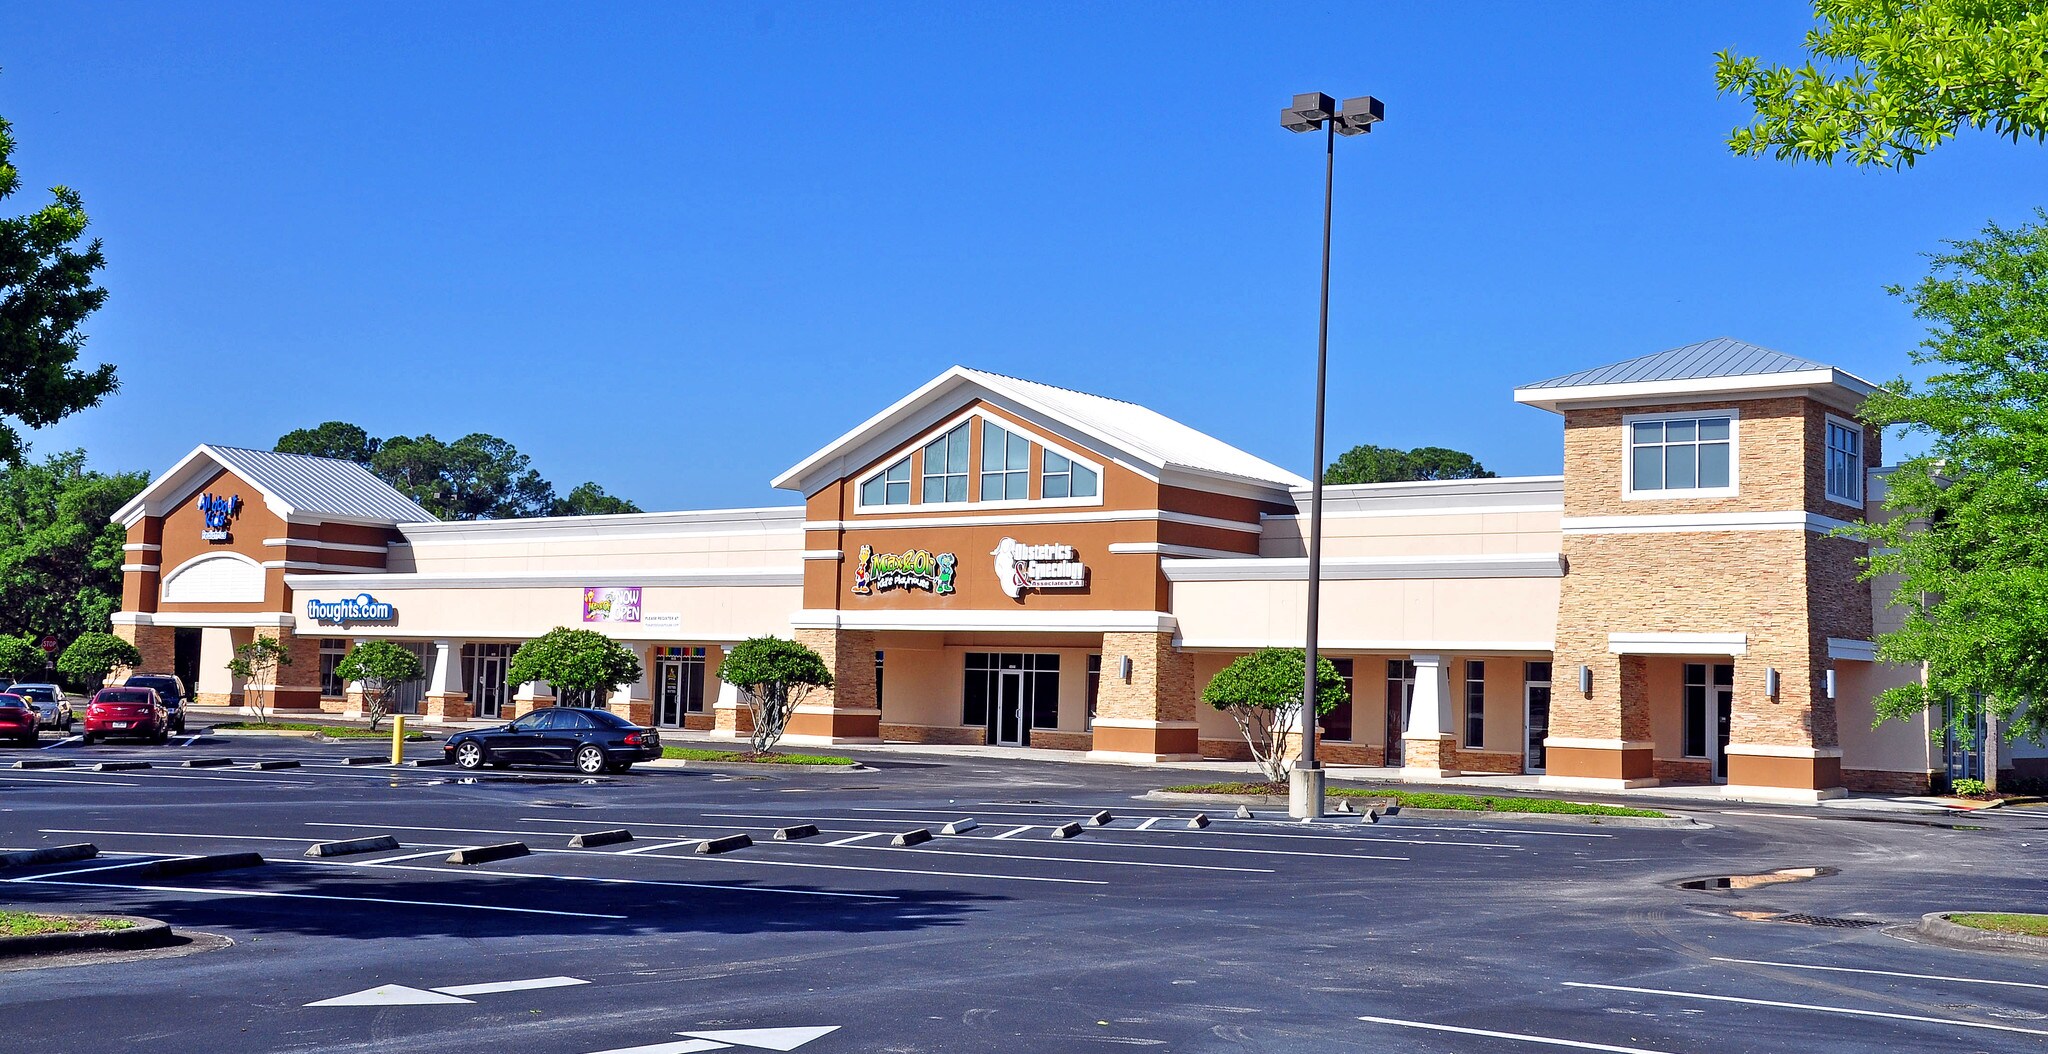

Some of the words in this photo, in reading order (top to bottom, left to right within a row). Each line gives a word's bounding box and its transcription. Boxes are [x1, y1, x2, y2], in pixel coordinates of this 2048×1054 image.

[1013, 543, 1073, 560] Obstetrics
[1012, 561, 1030, 587] &
[1028, 560, 1084, 580] Gynecology
[616, 589, 640, 605] NOW
[308, 600, 389, 622] thoughts.com
[614, 606, 640, 621] OPEN
[43, 640, 56, 648] STOP
